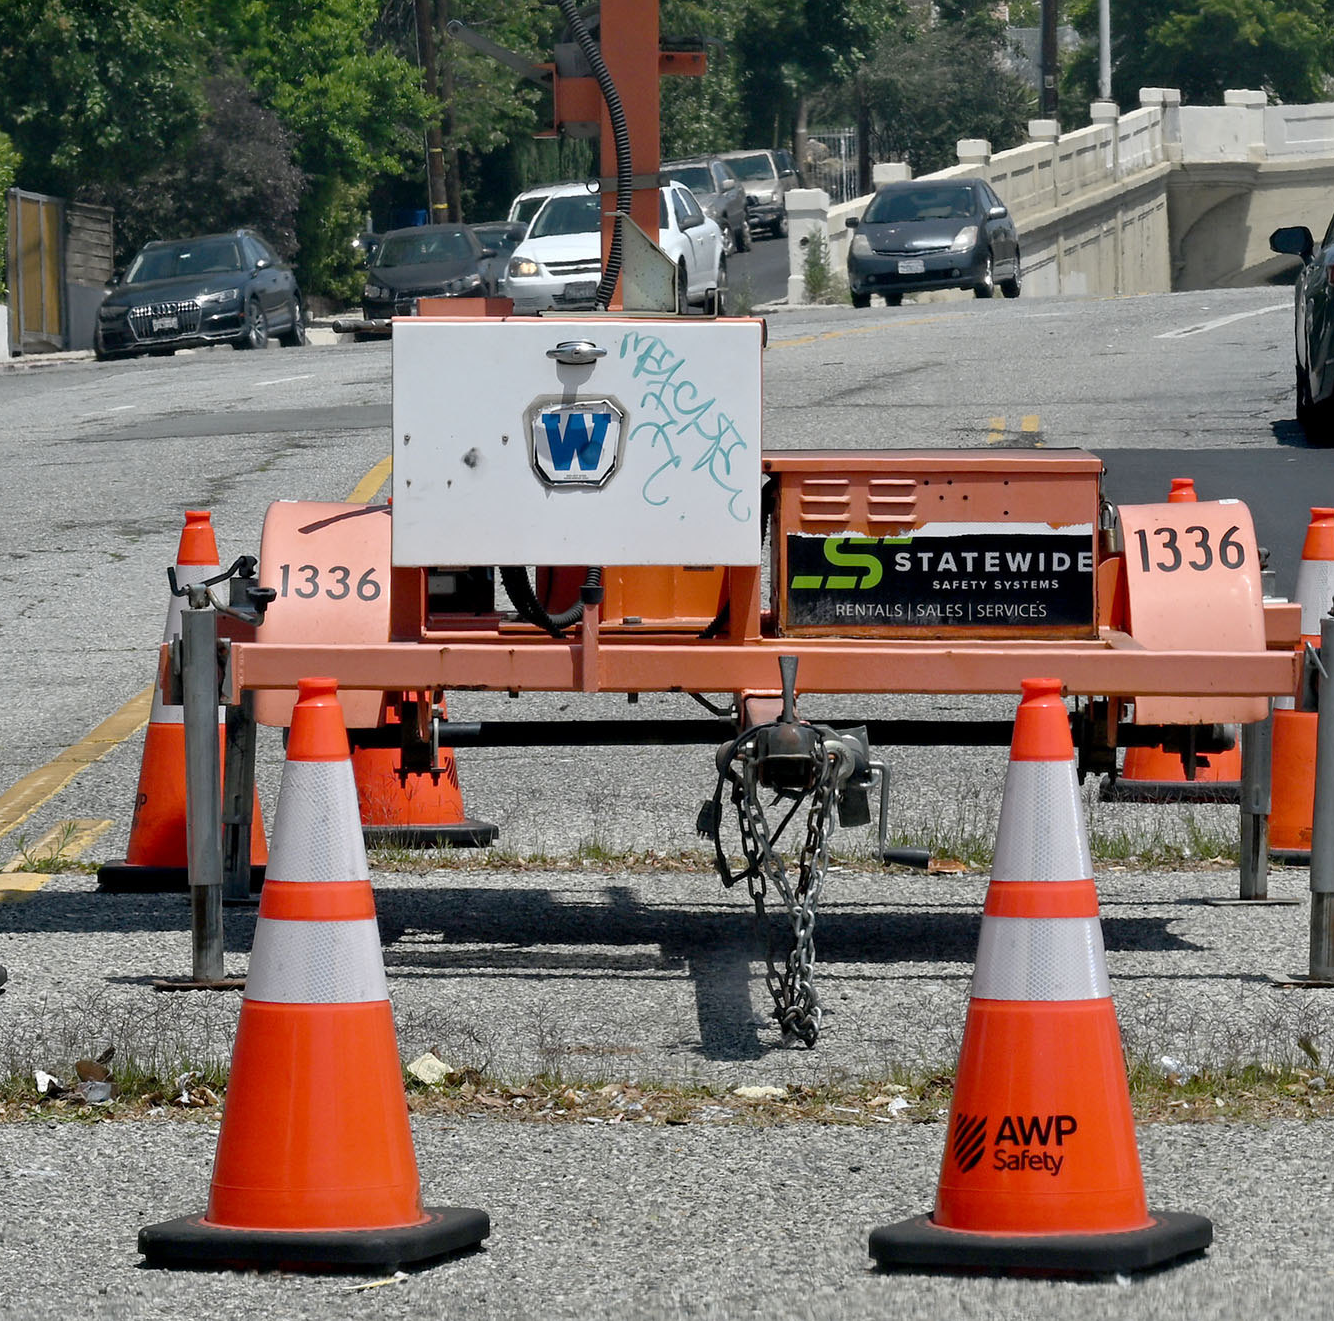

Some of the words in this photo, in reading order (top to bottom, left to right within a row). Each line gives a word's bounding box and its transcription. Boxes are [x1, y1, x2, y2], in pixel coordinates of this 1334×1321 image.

[541, 413, 612, 472] W
[893, 551, 1094, 573] STATEWIDE
[1134, 525, 1246, 573] 1336
[278, 563, 382, 602] 1336
[932, 580, 988, 591] SAFETY
[994, 579, 1060, 590] SYSTEMS
[835, 603, 904, 618] RENTALS
[917, 603, 964, 618] SALES
[977, 603, 1048, 618] SERVICES
[994, 1114, 1078, 1147] AWP
[993, 1148, 1064, 1177] Safety
